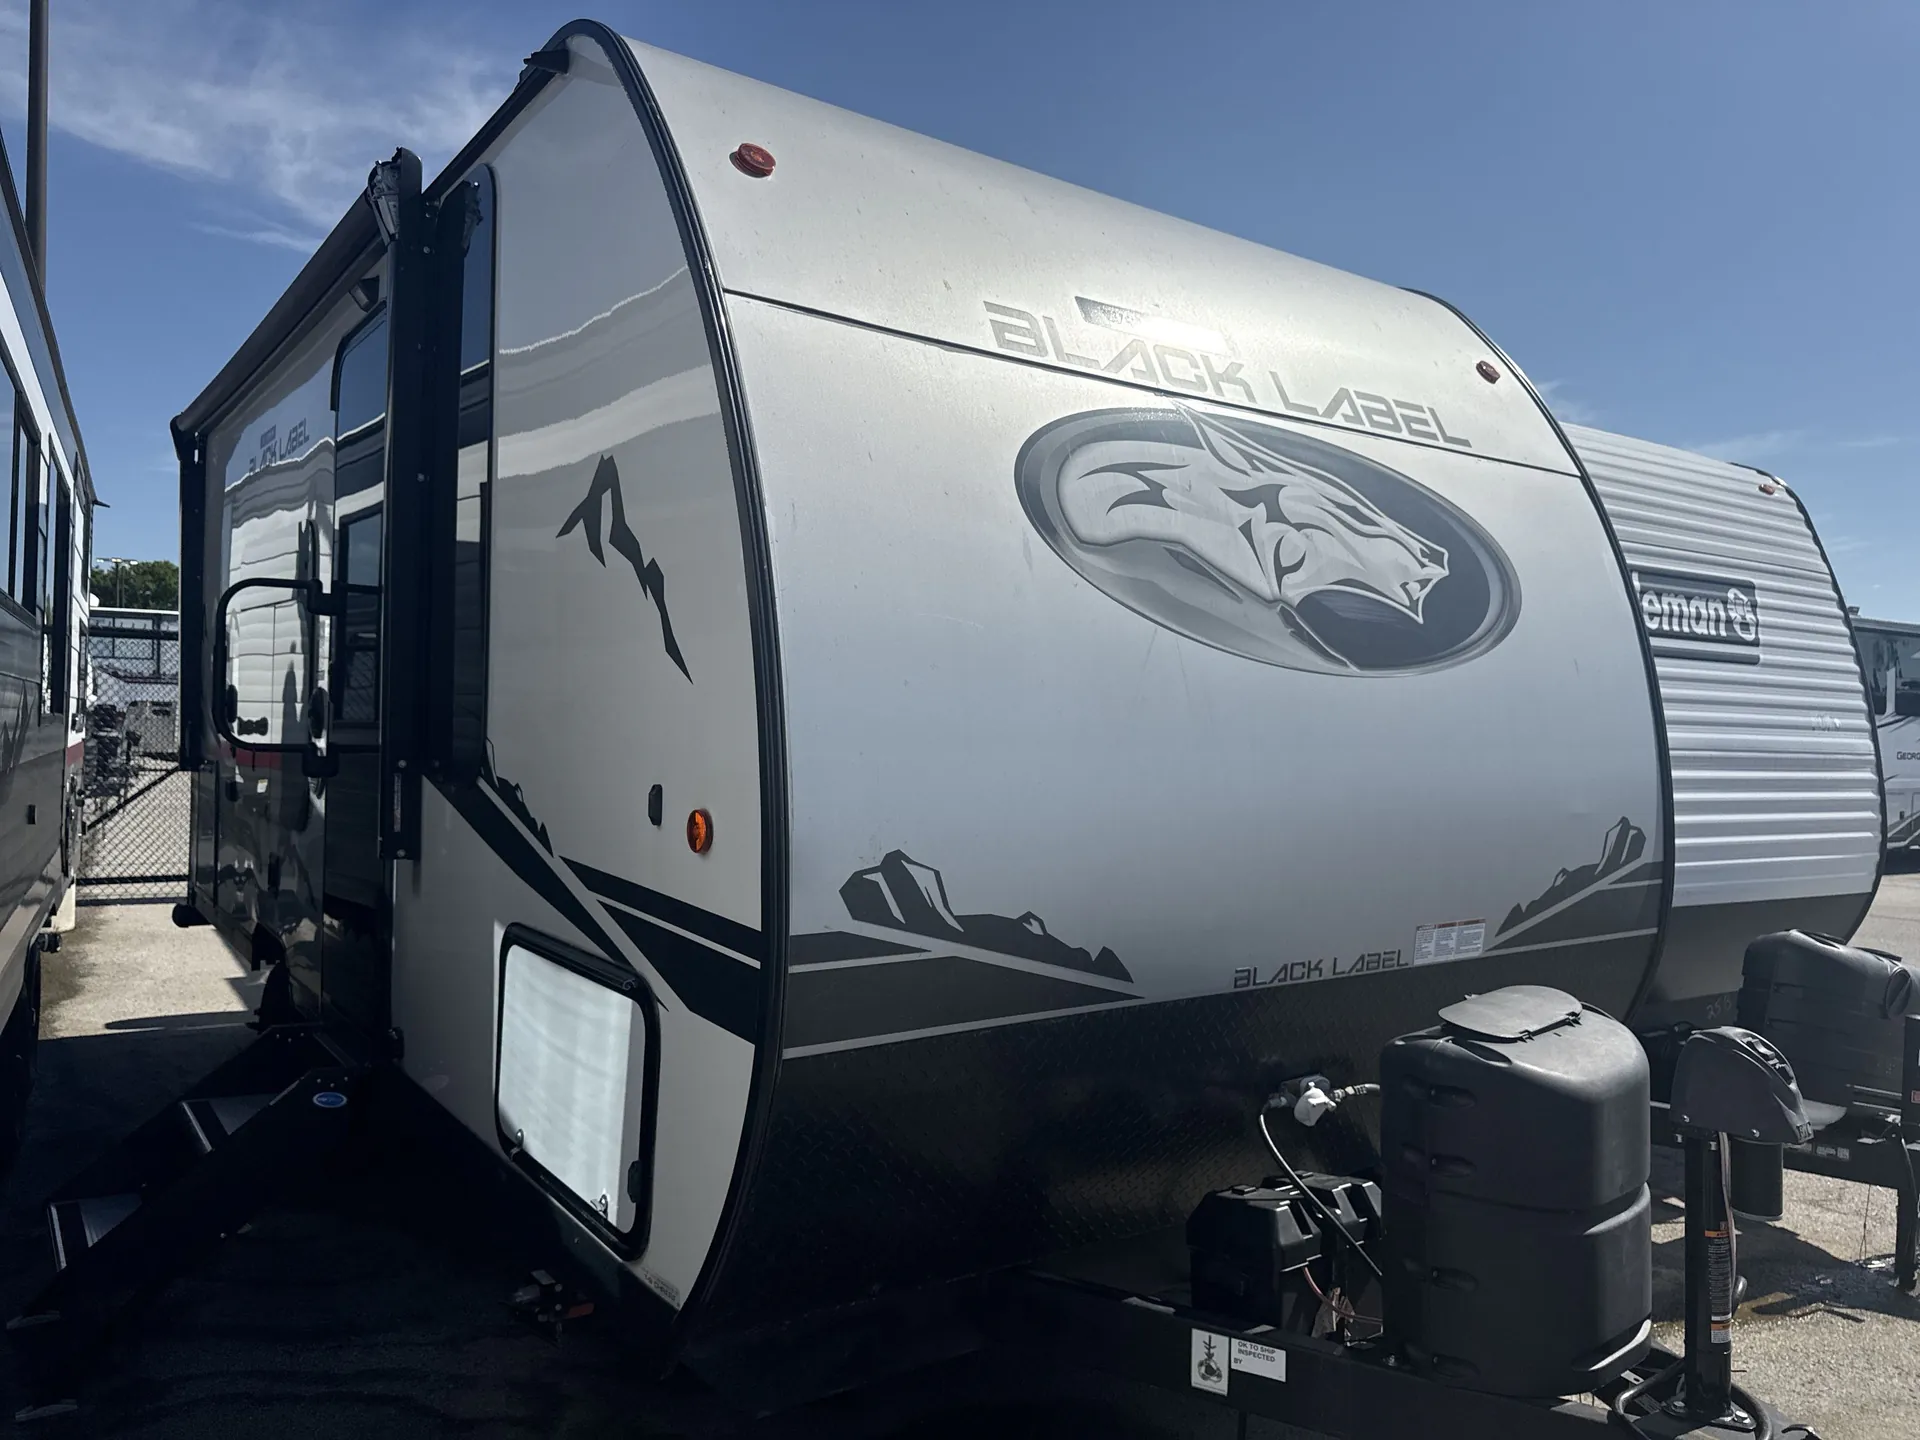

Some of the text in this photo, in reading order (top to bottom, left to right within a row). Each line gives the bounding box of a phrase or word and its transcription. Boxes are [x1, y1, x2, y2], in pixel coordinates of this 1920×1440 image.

[984, 301, 1472, 448] BLACK LABEL
[279, 417, 310, 461] LABEL
[1233, 949, 1409, 989] BLACK LABEL
[1233, 1357, 1243, 1365] BY
[1237, 1341, 1276, 1355] OK TO SHIP
[1237, 1348, 1276, 1363] INSPECTED
